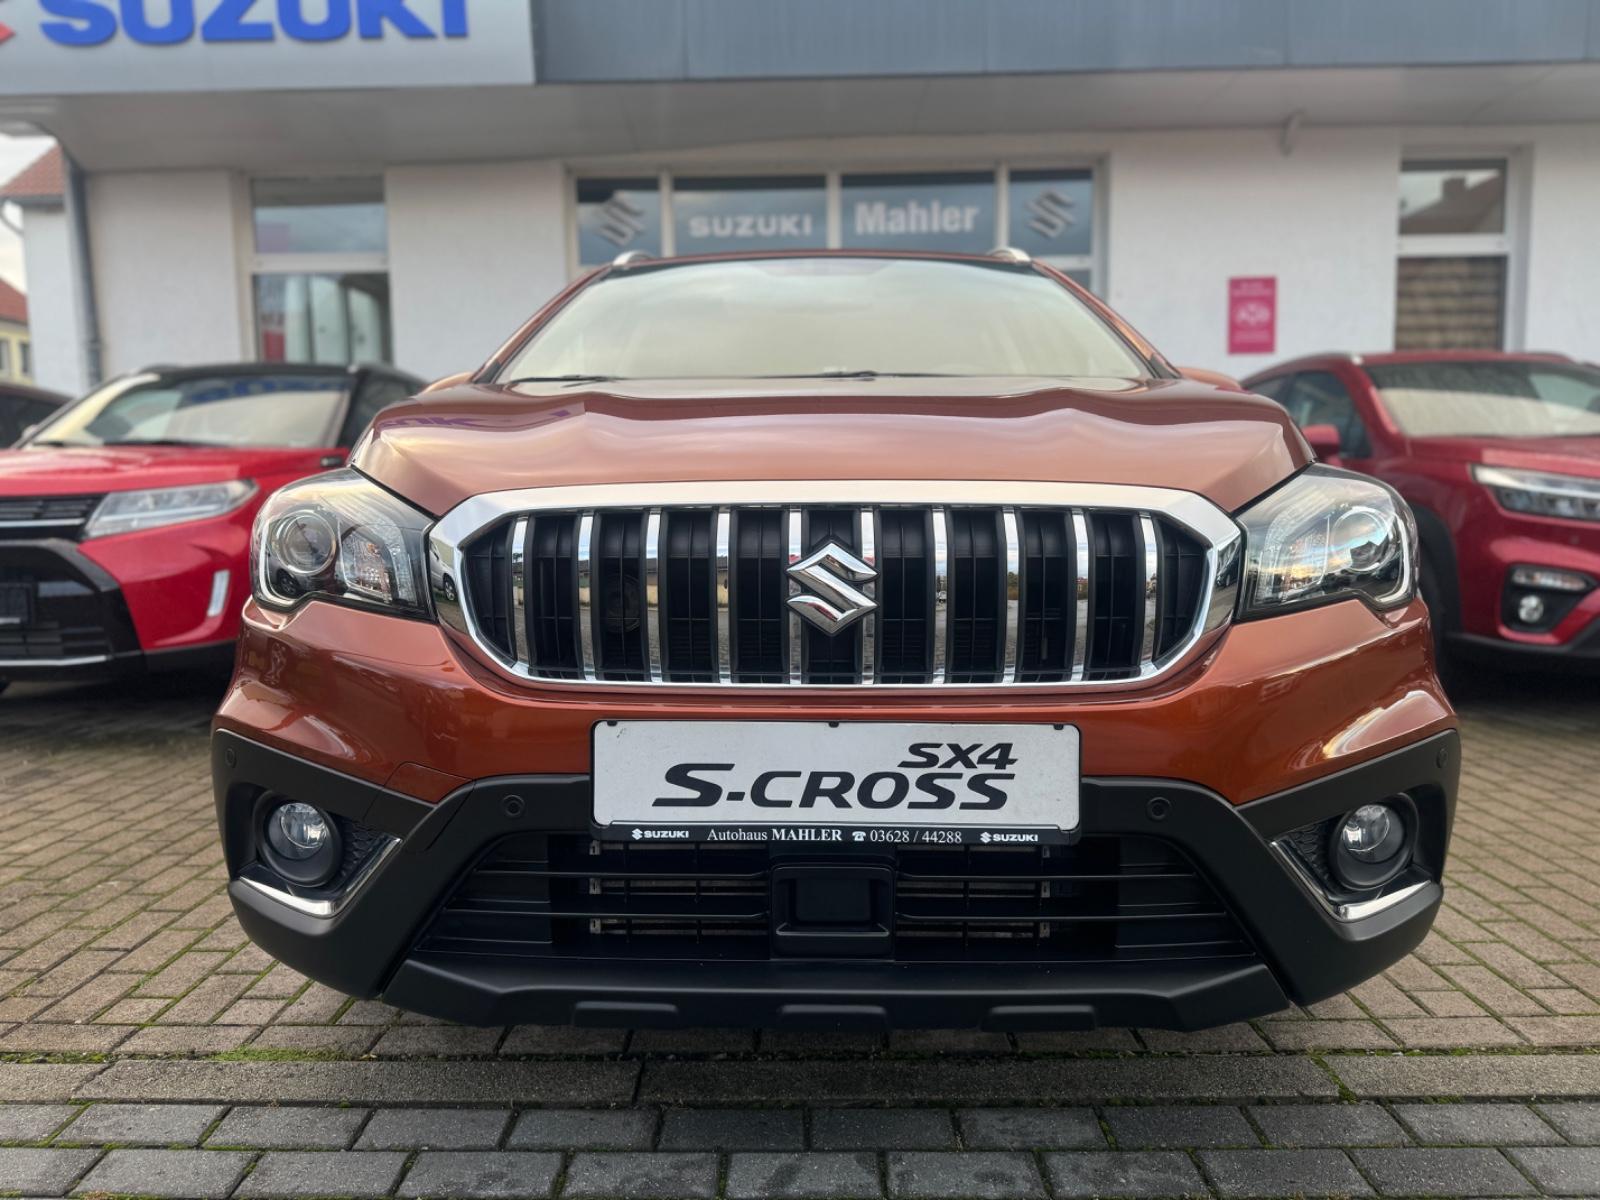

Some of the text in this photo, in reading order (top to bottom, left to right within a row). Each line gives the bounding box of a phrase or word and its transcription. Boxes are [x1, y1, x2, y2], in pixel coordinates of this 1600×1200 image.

[39, 0, 469, 47] SUZUKI
[688, 213, 812, 238] SUZUKI
[855, 200, 979, 234] Mahler
[897, 742, 1018, 770] SX4
[652, 763, 1016, 810] S-CROSS
[643, 830, 690, 840] SUZUKI
[706, 828, 768, 841] Autohaus
[771, 828, 843, 842] MAHLER
[869, 829, 911, 843] 03628
[921, 830, 963, 844] 44288
[992, 833, 1039, 842] SUZUKI
